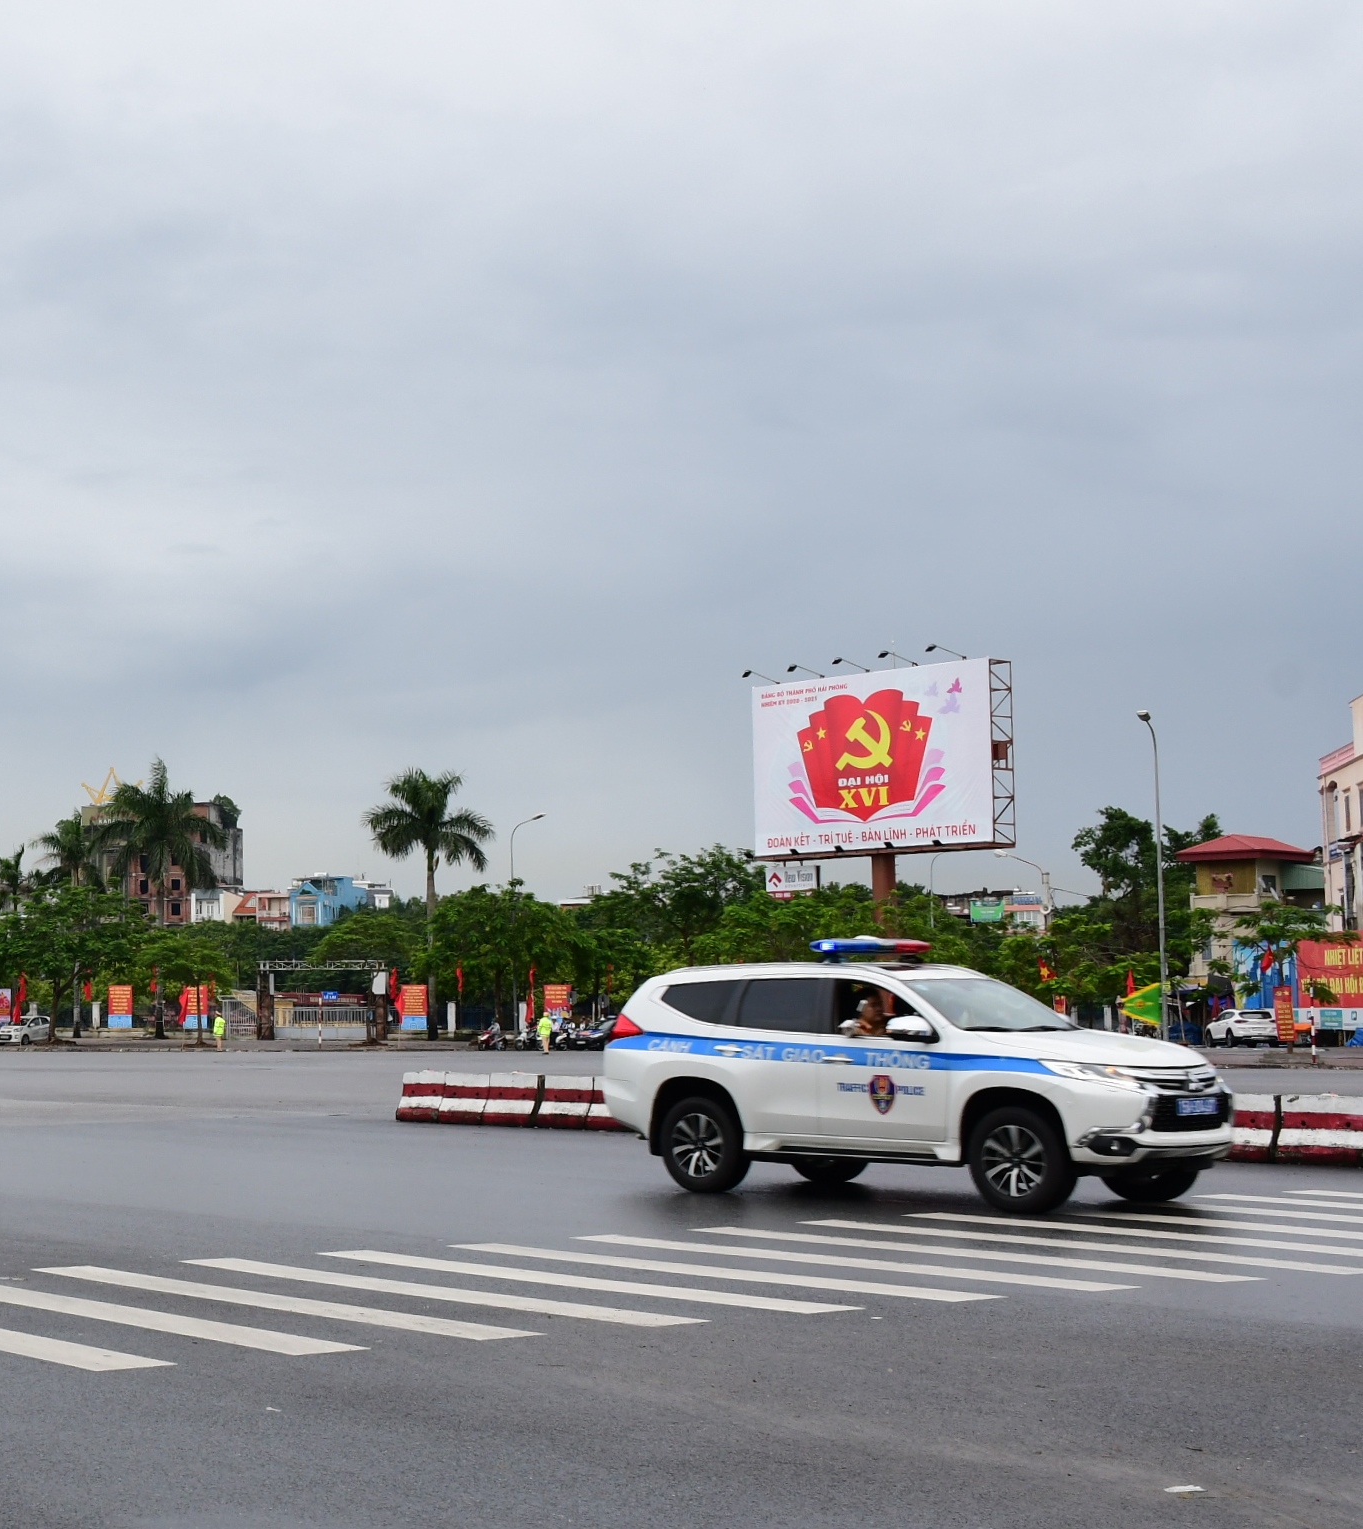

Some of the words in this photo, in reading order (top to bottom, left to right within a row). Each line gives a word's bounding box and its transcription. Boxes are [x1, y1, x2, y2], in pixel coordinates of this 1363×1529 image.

[838, 777, 861, 789] ĐẠI
[865, 774, 889, 787] HỘI
[838, 786, 890, 809] XVI
[767, 836, 792, 849] ĐOÀN
[794, 832, 810, 847] KẾT
[818, 831, 833, 845] TRÍ
[835, 829, 853, 845] TUỆ
[861, 828, 882, 842] BẢN
[884, 826, 907, 841] LĨNH
[915, 824, 942, 839] PHÁT
[945, 819, 976, 837] TRIỂN
[797, 870, 813, 882] Vision
[1324, 945, 1346, 969] NHIỆT
[1345, 974, 1358, 998] HỘI
[647, 1038, 693, 1054] CẢNH
[741, 1042, 776, 1061] SÁT
[782, 1047, 826, 1064] GIAO
[866, 1050, 931, 1070] THÔNG
[837, 1082, 869, 1093] TRAFFIC
[897, 1085, 926, 1096] POLICE
